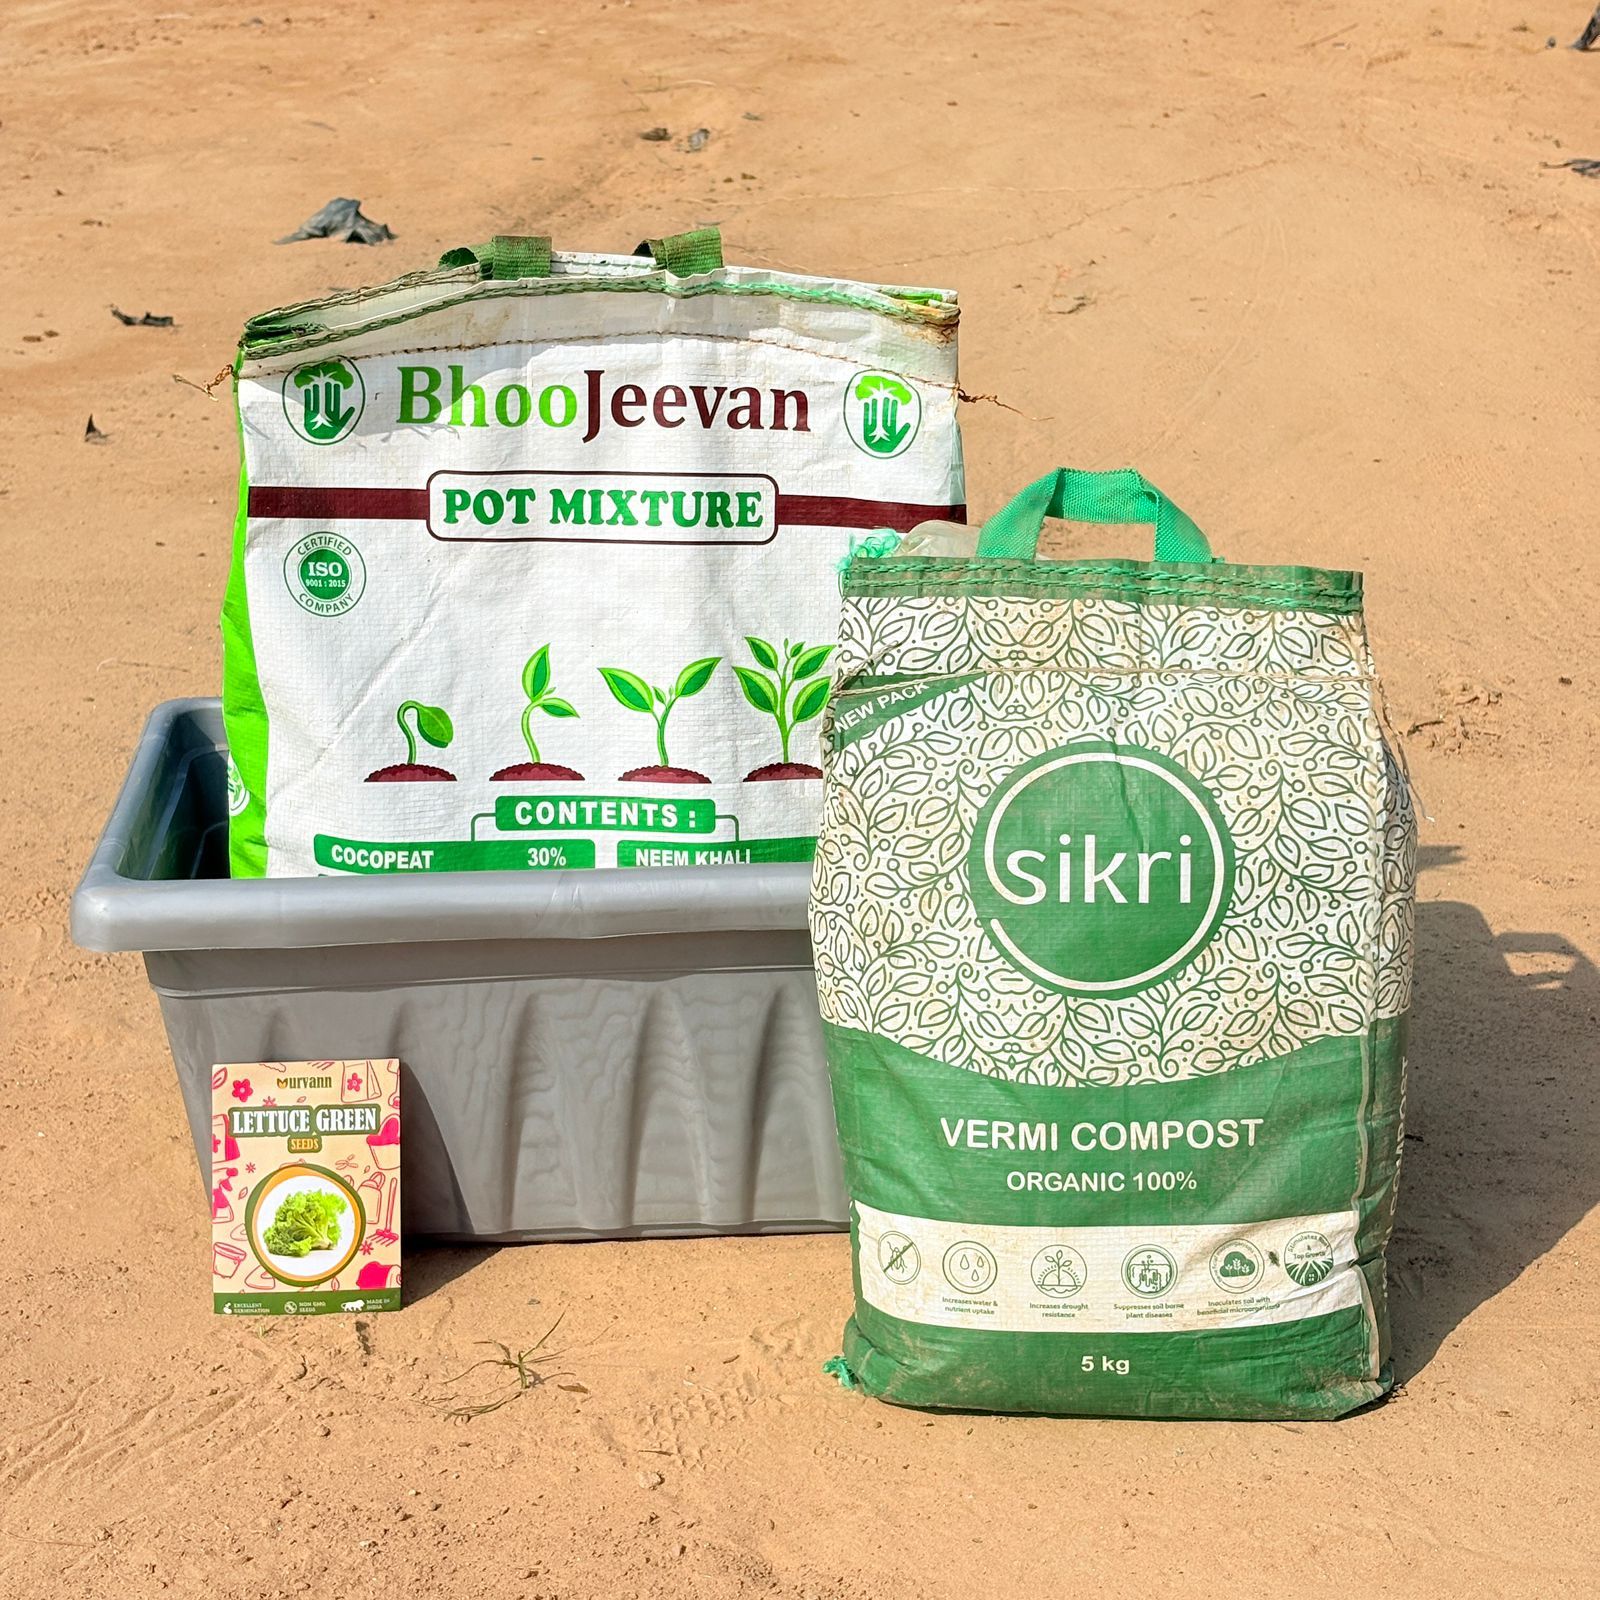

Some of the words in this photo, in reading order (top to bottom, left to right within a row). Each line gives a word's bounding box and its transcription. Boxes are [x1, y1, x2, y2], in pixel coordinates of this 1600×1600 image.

[396, 365, 811, 443] BhooJeevan
[442, 488, 536, 525] POT
[549, 489, 763, 528] MIXTURE
[297, 536, 352, 555] CERTIFIED
[308, 562, 343, 576] ISO
[305, 579, 323, 587] 9001
[328, 580, 346, 588] 2015
[299, 593, 354, 613] COMPANY
[834, 701, 875, 733] NEW
[877, 682, 930, 709] PACK
[514, 801, 678, 828] CONTENTS
[331, 844, 434, 869] COCOPEAT
[527, 847, 567, 867] 30%
[635, 848, 689, 867] NEEM
[695, 848, 751, 865] KHALI
[1005, 834, 1192, 905] sikri
[232, 1109, 310, 1134] LETTUCE
[316, 1107, 377, 1132] GREEN
[940, 1117, 1058, 1151] VERMI
[1071, 1118, 1265, 1151] COMPOST
[290, 1138, 319, 1150] SEEDS
[1006, 1171, 1125, 1192] ORGANIC
[1133, 1171, 1197, 1191] 100%
[942, 1296, 973, 1305] Increases
[972, 1299, 992, 1307] water
[944, 1305, 971, 1314] nutrient
[971, 1307, 995, 1316] uptake
[1029, 1302, 1060, 1310] Increases
[1061, 1303, 1089, 1311] drought
[1113, 1303, 1151, 1311] Suppresses
[1208, 1298, 1242, 1306] Inoculates
[1255, 1296, 1271, 1304] with
[1125, 1312, 1143, 1320] plant
[1081, 1355, 1095, 1372] 5
[1101, 1355, 1130, 1375] kg
